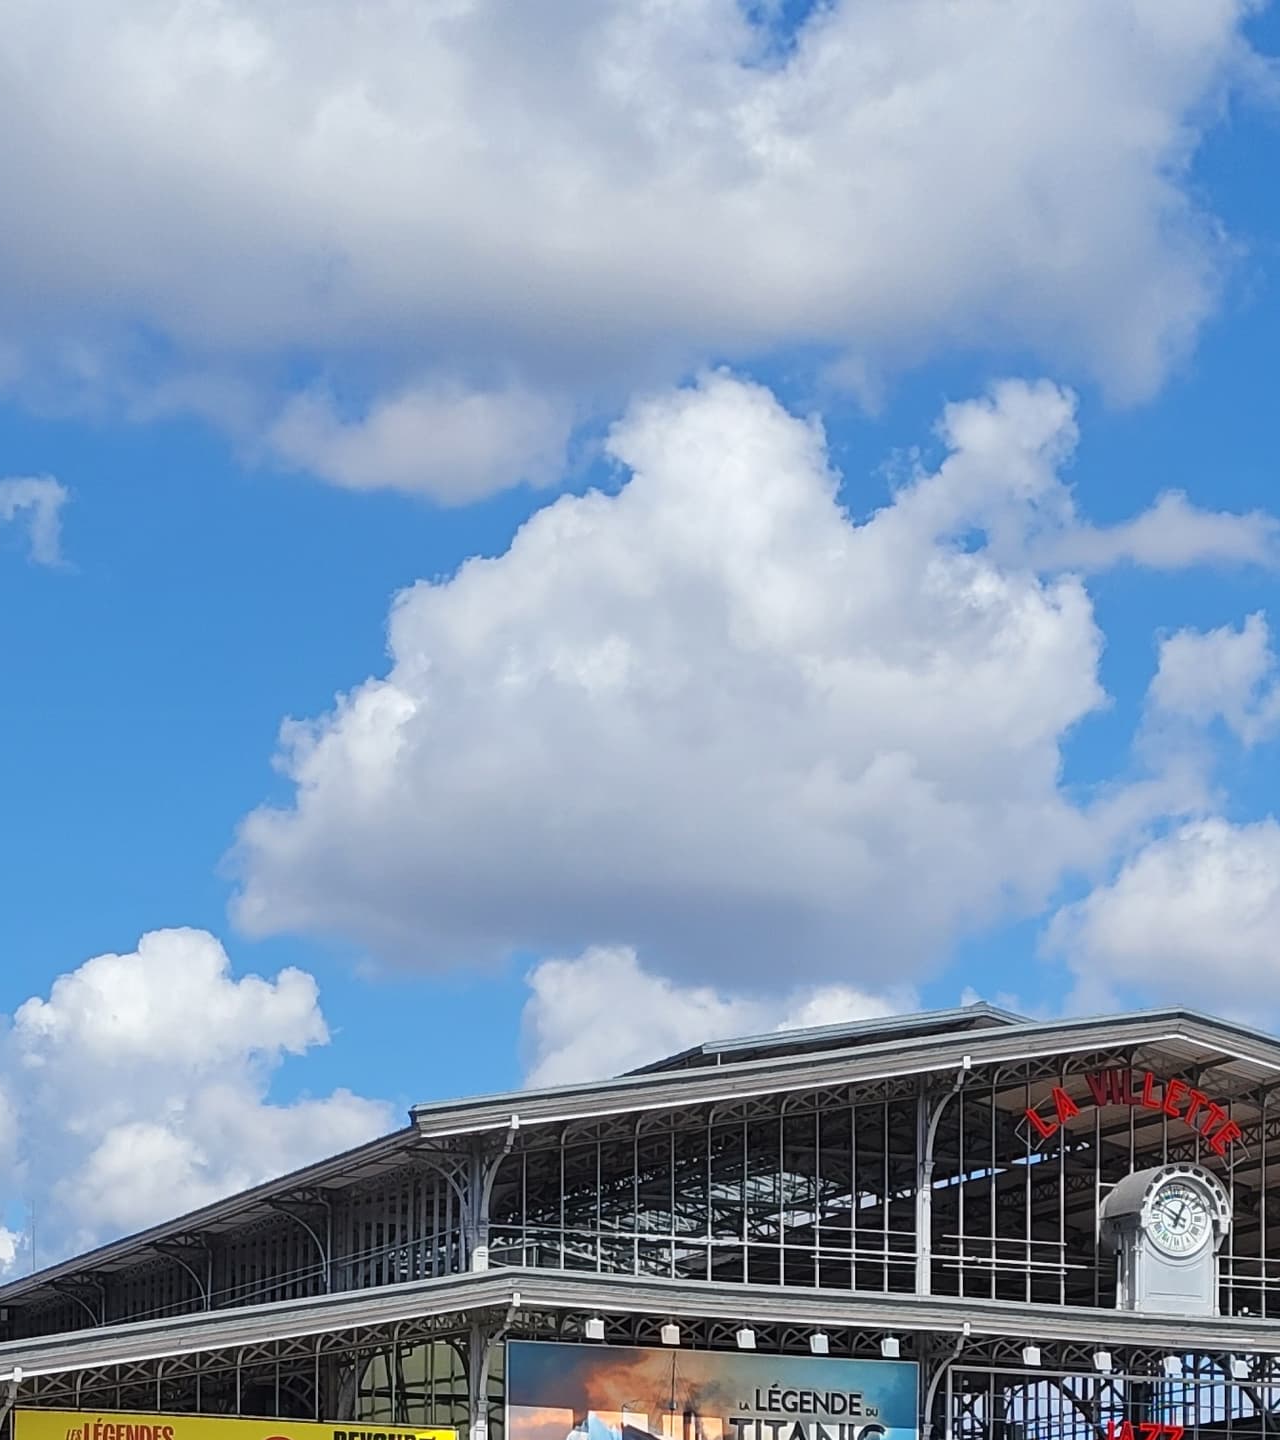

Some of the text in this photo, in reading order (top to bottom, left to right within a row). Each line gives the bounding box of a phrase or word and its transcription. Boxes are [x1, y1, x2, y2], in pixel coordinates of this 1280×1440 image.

[1025, 1069, 1242, 1157] LA VILLETTE
[739, 1383, 879, 1417] LA LÉGENDE DU
